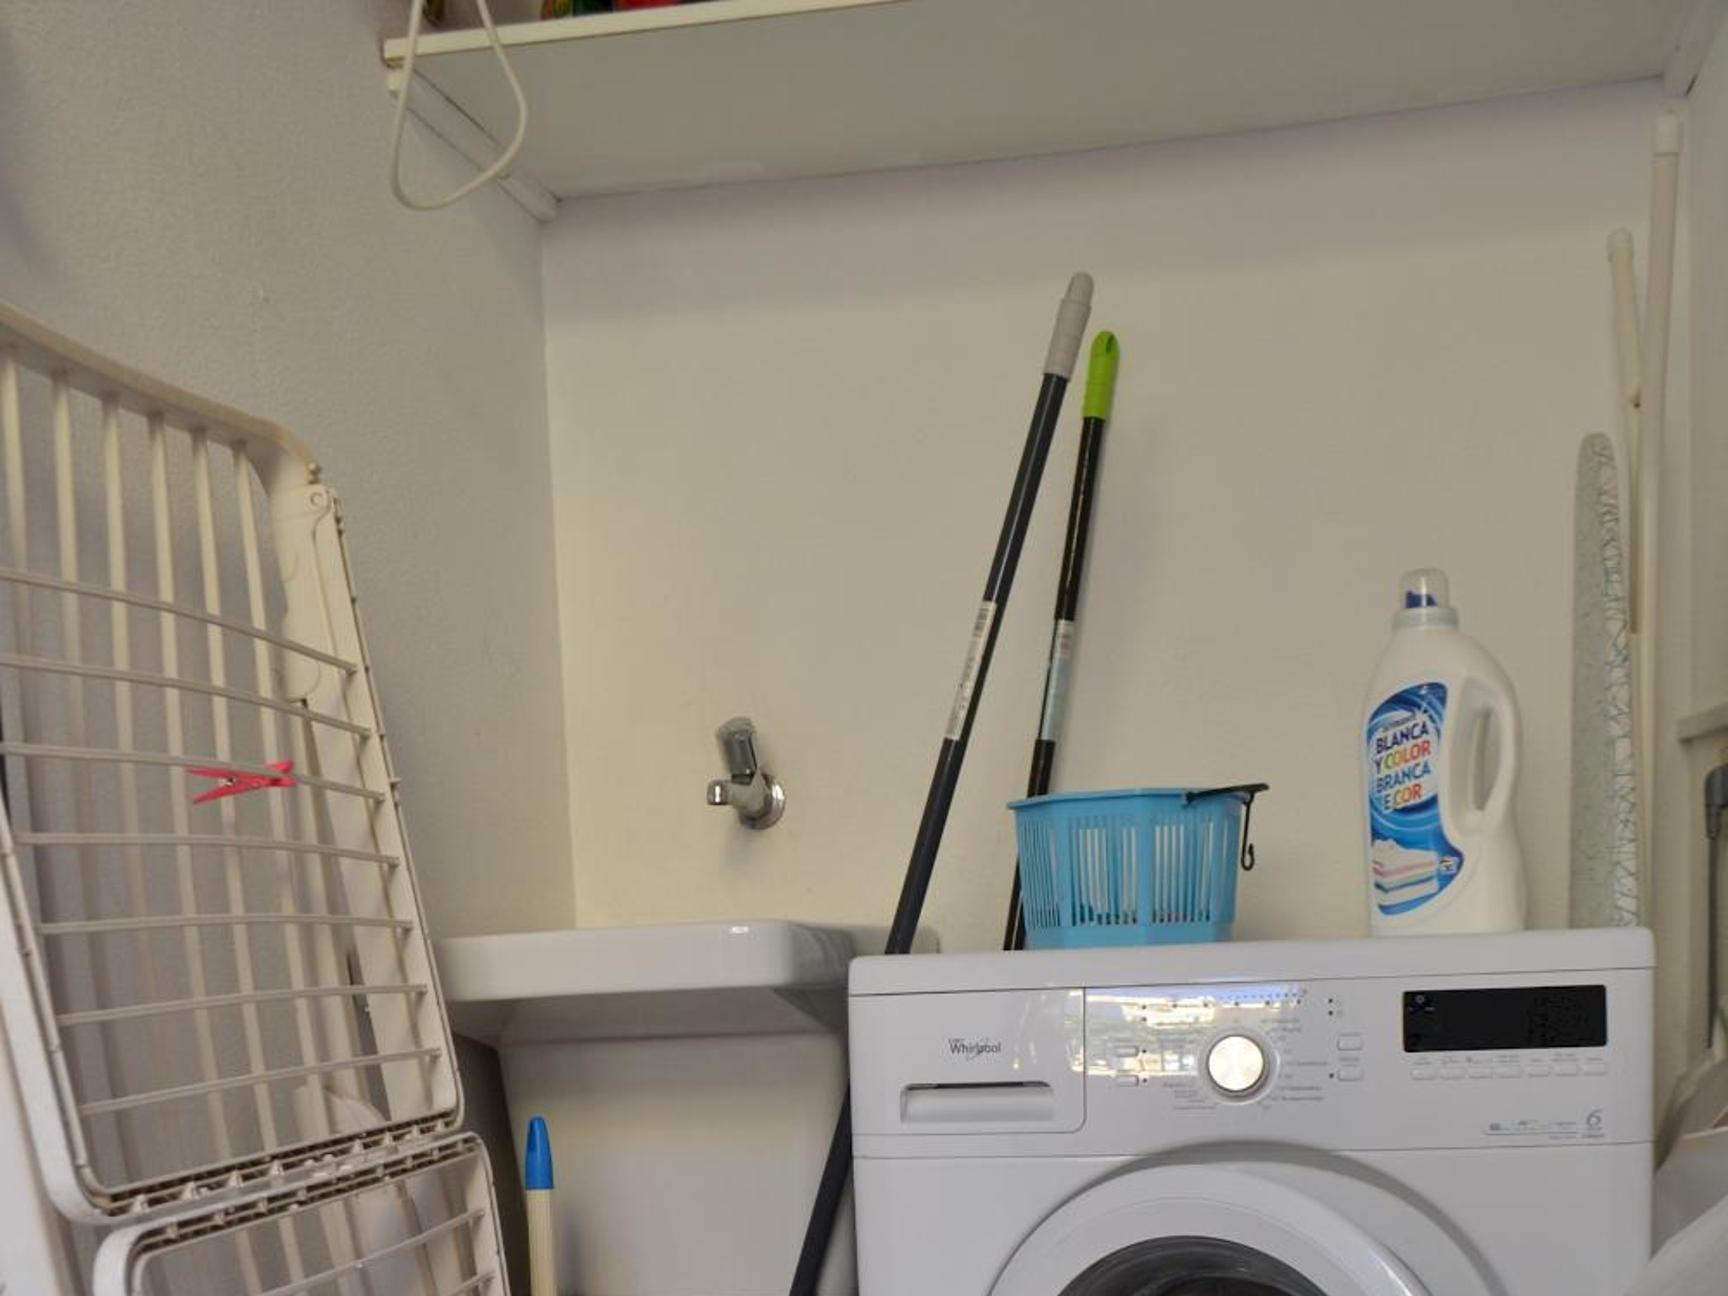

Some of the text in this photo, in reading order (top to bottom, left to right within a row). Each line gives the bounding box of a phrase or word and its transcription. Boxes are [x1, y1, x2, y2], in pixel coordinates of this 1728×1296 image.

[1376, 720, 1429, 754] BLANCA
[1375, 740, 1431, 774] Y COLOR
[1376, 760, 1431, 794] BRANCA
[1393, 783, 1422, 806] COR
